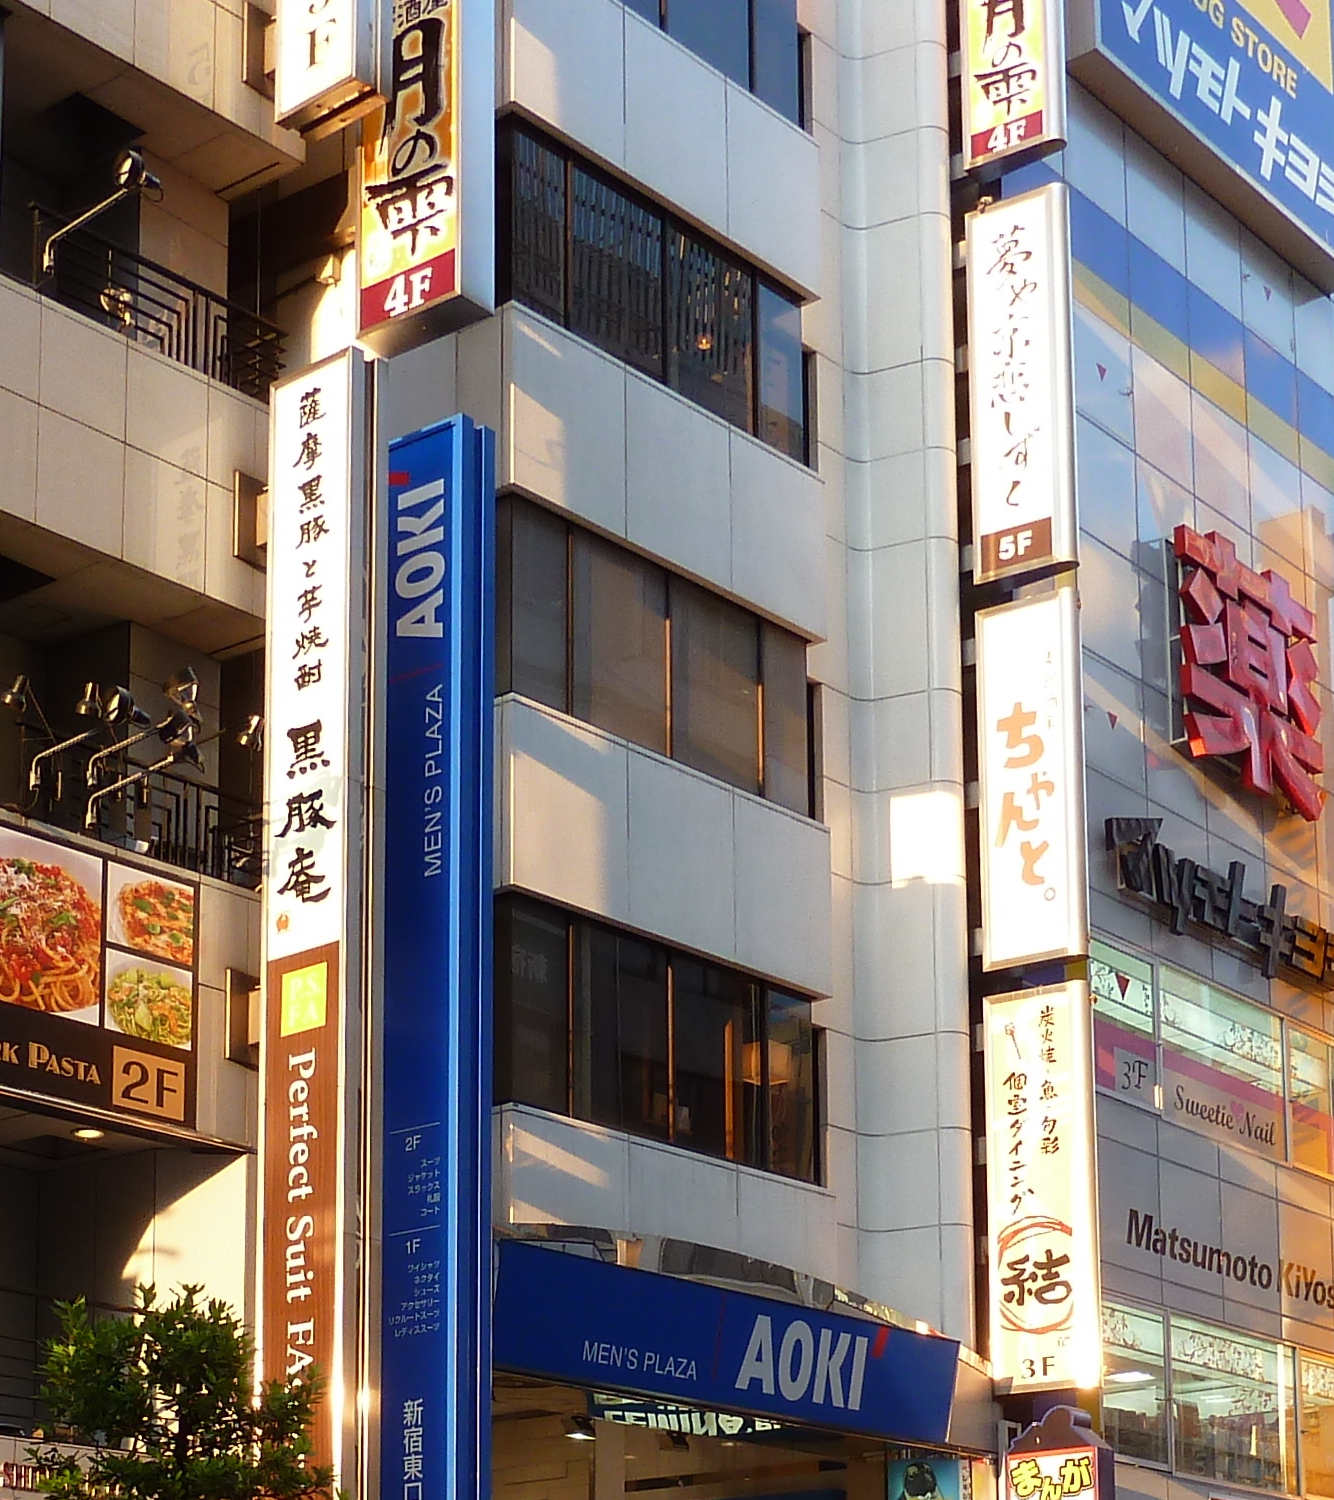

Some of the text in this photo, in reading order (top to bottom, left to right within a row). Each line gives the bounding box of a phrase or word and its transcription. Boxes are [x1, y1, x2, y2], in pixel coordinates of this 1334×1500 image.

[1231, 22, 1298, 98] STORE
[366, 18, 454, 258] 月の雫
[987, 120, 1025, 154] 4F
[384, 266, 433, 318] 4F
[291, 387, 329, 690] 薩摩黒豚と芋焼酎
[393, 476, 446, 639] AOKI
[998, 529, 1033, 562] 5F
[1173, 523, 1327, 822] 薬
[423, 684, 444, 877] MEN'S PLAZA
[995, 702, 1056, 902] ちゃんと。
[277, 719, 337, 904] 黒豚庵
[27, 1042, 102, 1086] PASTA
[120, 1061, 180, 1110] 2F
[1119, 1058, 1149, 1092] 3F
[287, 1047, 319, 1203] Perfect
[405, 1135, 421, 1151] 2F
[1173, 1084, 1277, 1147] Sweetie Nail
[421, 1156, 440, 1167] スーツ
[421, 1207, 440, 1217] コート
[285, 1215, 315, 1304] Suit
[406, 1239, 421, 1254] 1F
[1125, 1208, 1272, 1291] Matsumoto
[1001, 1248, 1073, 1307] 結
[582, 1340, 698, 1381] MEN'S PLAZA
[735, 1313, 870, 1411] AOKI
[1021, 1357, 1056, 1379] 3F
